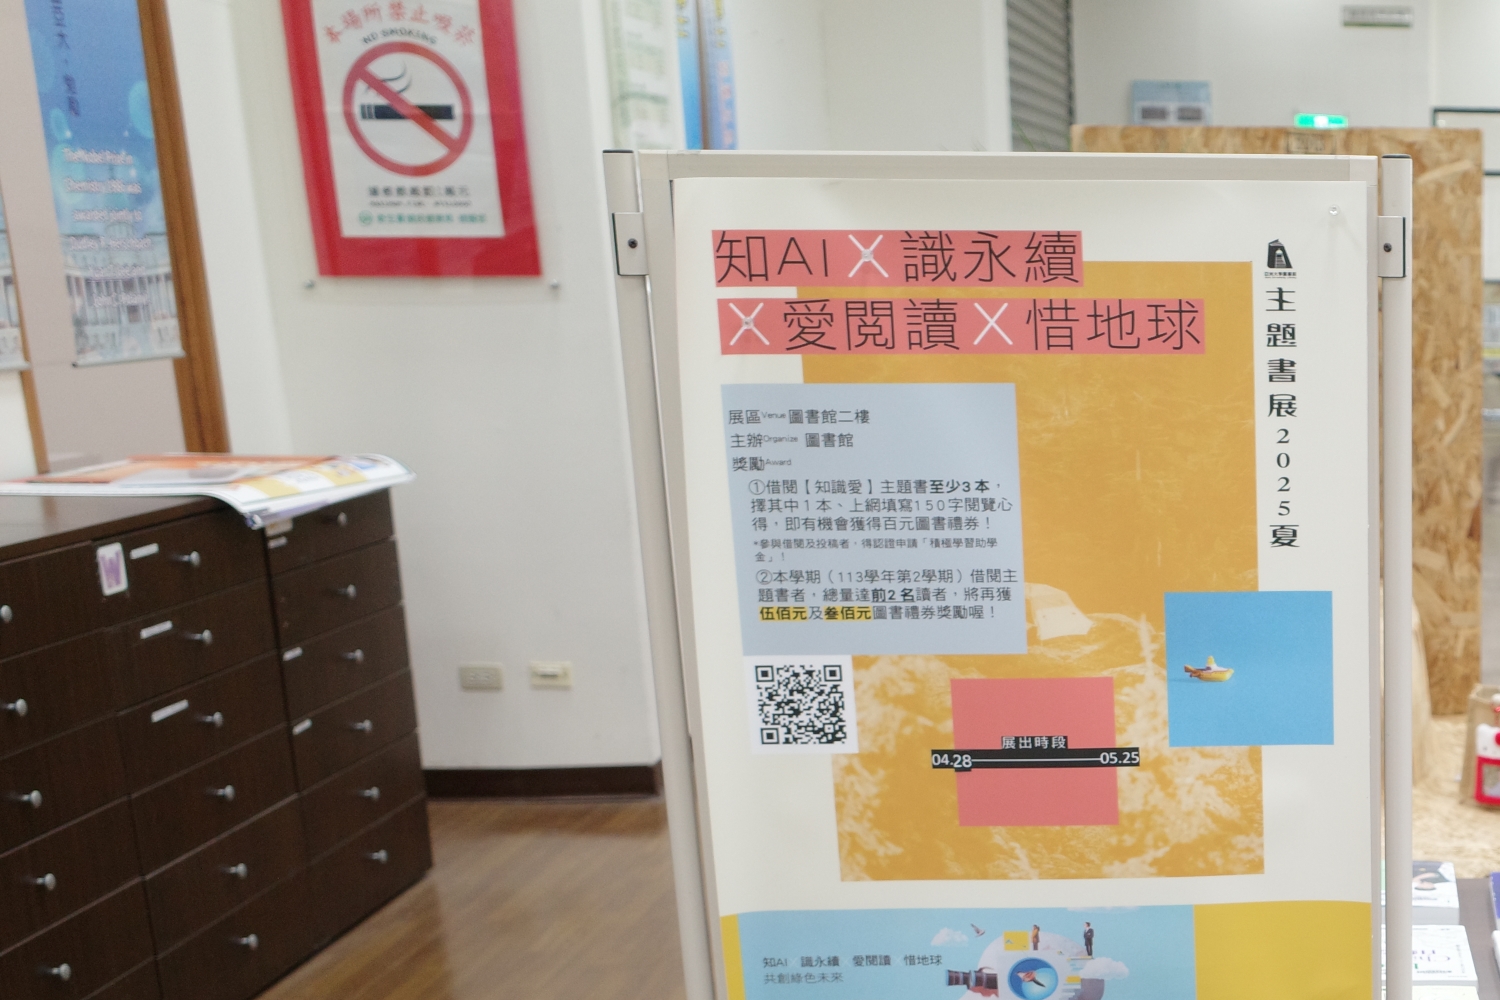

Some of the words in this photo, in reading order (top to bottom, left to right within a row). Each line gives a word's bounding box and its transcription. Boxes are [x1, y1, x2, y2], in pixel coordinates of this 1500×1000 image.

[715, 231, 828, 284] 知AI
[903, 231, 1079, 284] 識永續
[782, 299, 961, 352] 愛閱讀
[1024, 299, 1203, 352] 惜地球
[728, 409, 762, 426] 展區
[788, 409, 870, 426] 圖書館二樓
[730, 433, 763, 449] 主辦
[805, 432, 854, 448] 圖書館
[1001, 735, 1067, 750] 展出時段
[931, 752, 973, 769] 04.28
[1099, 750, 1140, 766] 05.25
